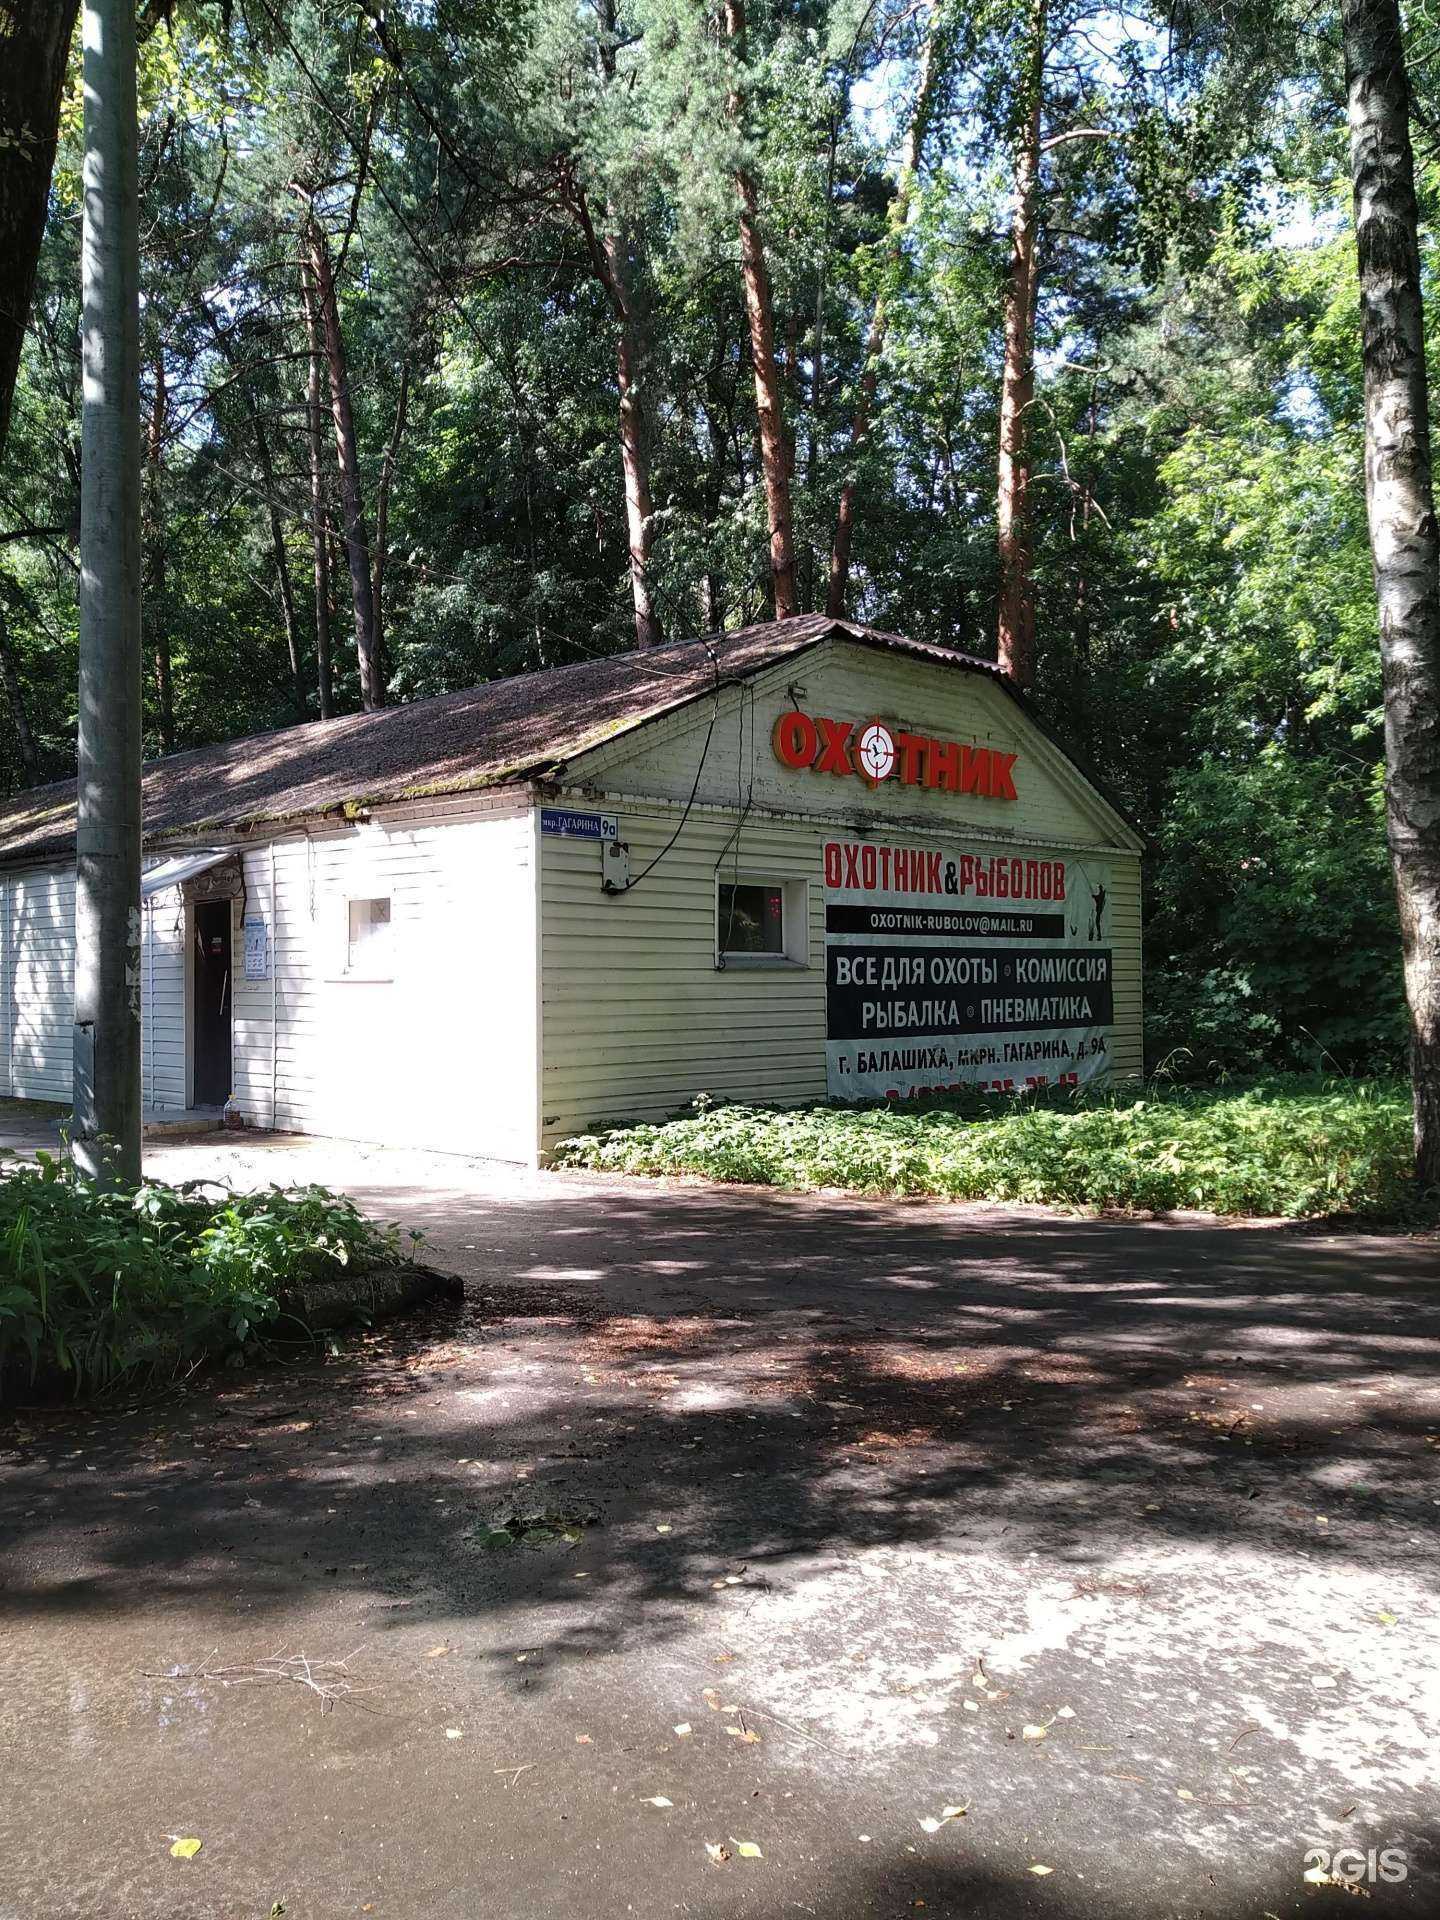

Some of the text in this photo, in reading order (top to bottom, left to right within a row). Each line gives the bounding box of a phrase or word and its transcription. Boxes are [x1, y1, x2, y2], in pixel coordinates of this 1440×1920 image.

[772, 711, 1018, 801] ОХОТНИК
[870, 913, 1033, 935] OXOTNIK-RUBOLOV@MAIL.RU
[836, 956, 1107, 990] ВСЕ ДЛЯ ОХОТЫ КОМИССИЯ
[862, 996, 1093, 1029] РЫБАЛКА ПНЕВМАТИКА
[857, 1046, 954, 1074] БАЛАШИХА,
[1003, 1039, 1074, 1063] ГАГАРИНА,
